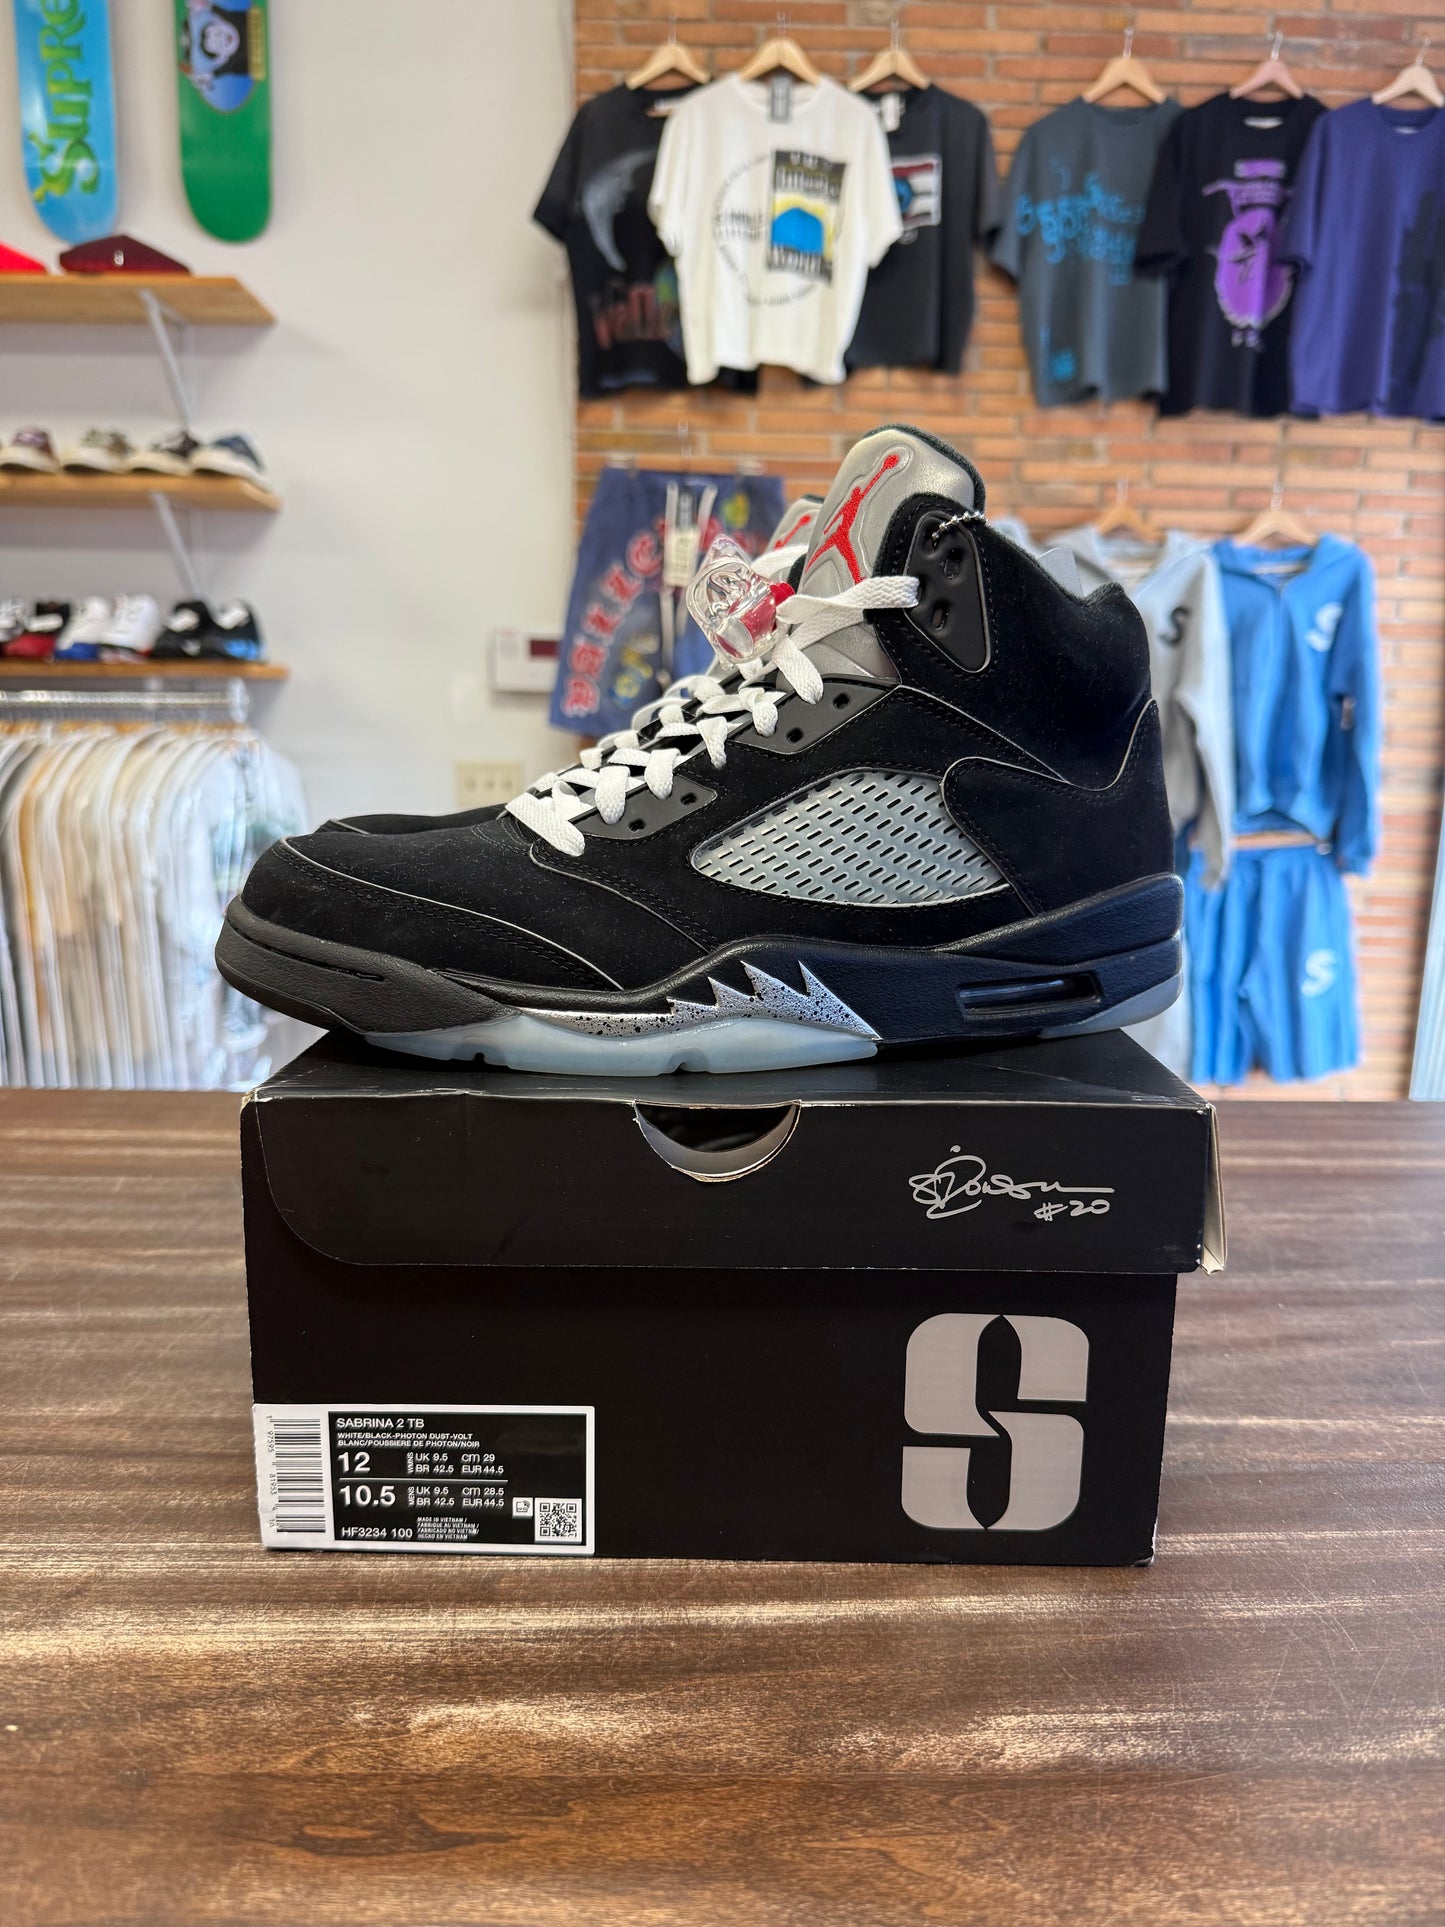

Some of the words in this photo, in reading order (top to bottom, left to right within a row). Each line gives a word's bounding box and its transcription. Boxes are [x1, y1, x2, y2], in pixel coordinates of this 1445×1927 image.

[1033, 1199, 1111, 1222] #20
[336, 1418, 395, 1429] SABRINA
[396, 1418, 405, 1429] 2
[407, 1418, 425, 1429] TB
[901, 1312, 1090, 1532] S
[337, 1432, 427, 1440] WHITE/BLACK-PHOTON
[337, 1451, 371, 1473] 12
[415, 1453, 430, 1462] UK
[433, 1453, 448, 1462] 9.5
[483, 1454, 496, 1463] 29
[415, 1464, 430, 1474] BR
[433, 1464, 454, 1474] 42.5
[461, 1465, 482, 1474] EUR
[483, 1465, 504, 1474] 44.5
[339, 1484, 396, 1506] 10.5
[416, 1486, 431, 1495] UK
[433, 1487, 449, 1496] 9.5
[483, 1487, 505, 1496] 28.5
[416, 1497, 431, 1507] BR
[434, 1497, 455, 1507] 42.5
[462, 1498, 482, 1507] EUR
[483, 1498, 505, 1507] 44.5
[341, 1526, 387, 1538] HF3234
[391, 1527, 413, 1539] 100
